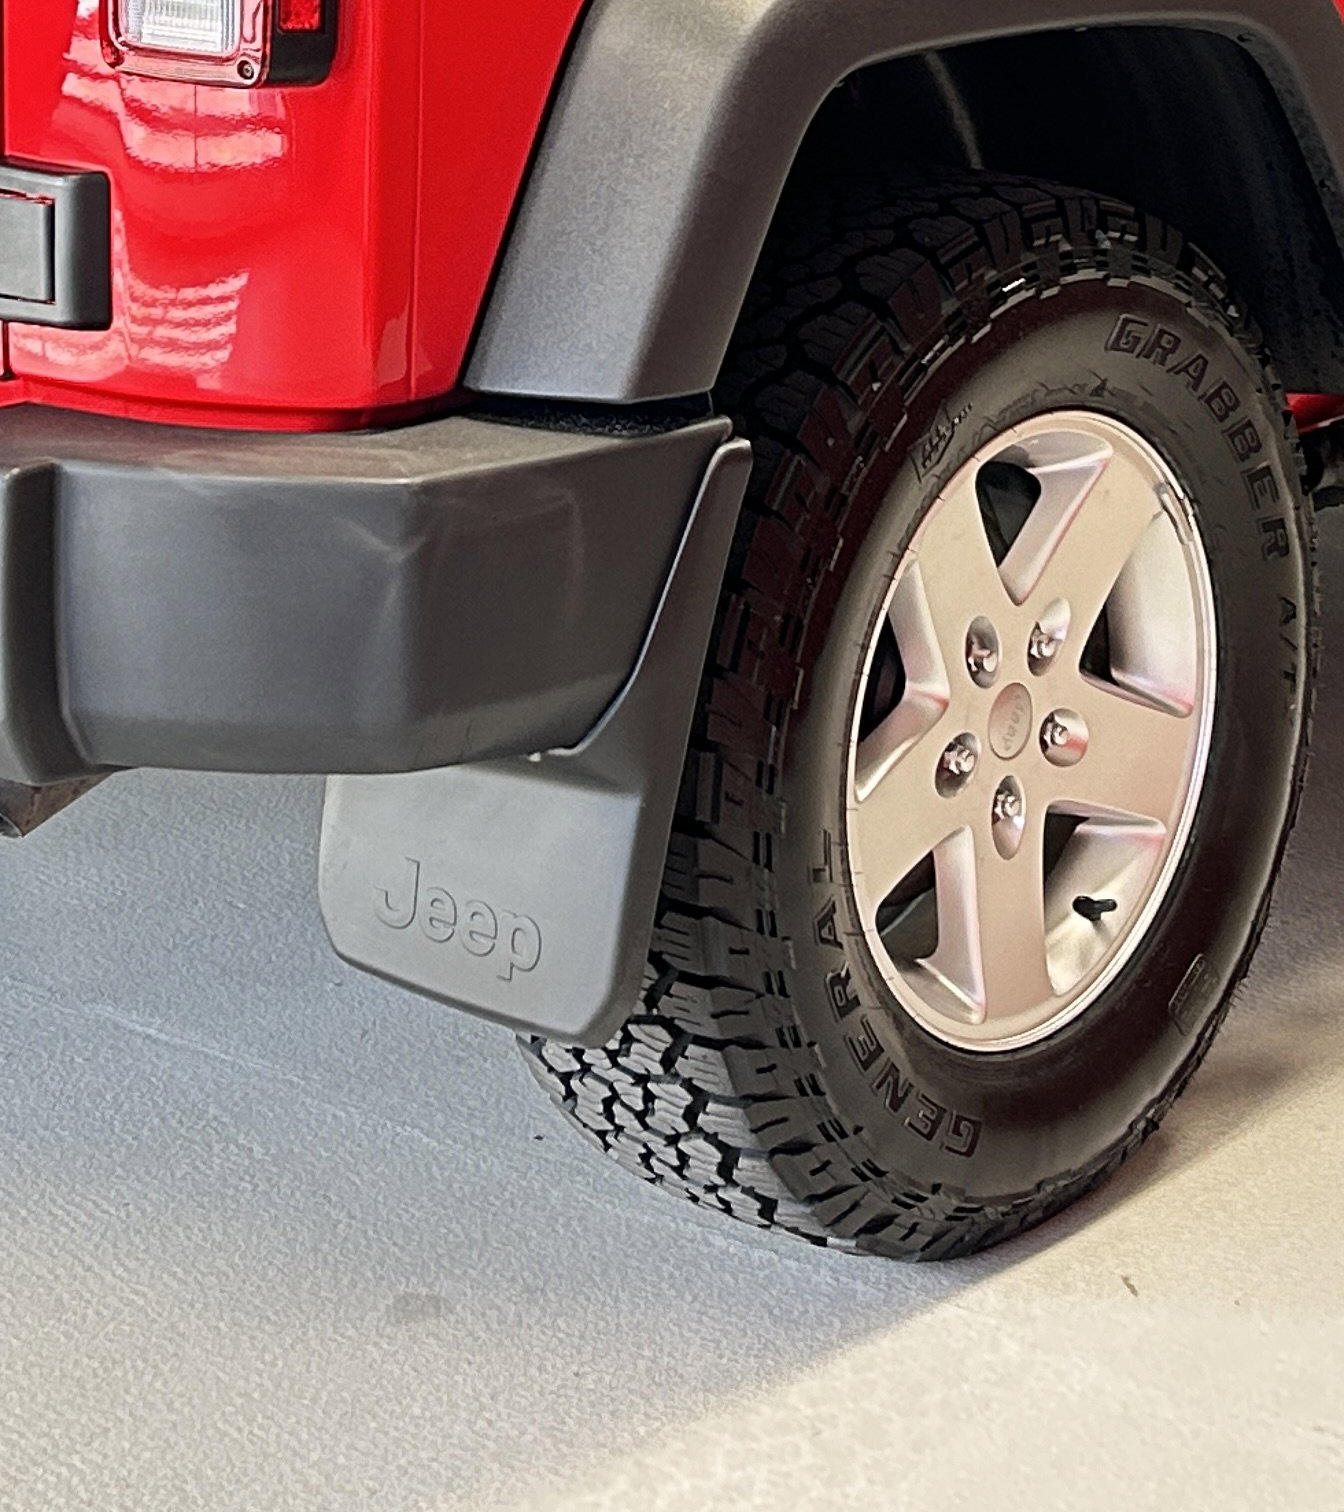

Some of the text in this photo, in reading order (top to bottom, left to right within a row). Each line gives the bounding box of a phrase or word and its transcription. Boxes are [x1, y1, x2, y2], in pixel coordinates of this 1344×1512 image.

[1105, 312, 1291, 563] GRABBER
[371, 855, 543, 982] Jeep
[807, 827, 984, 1159] GENERAL
